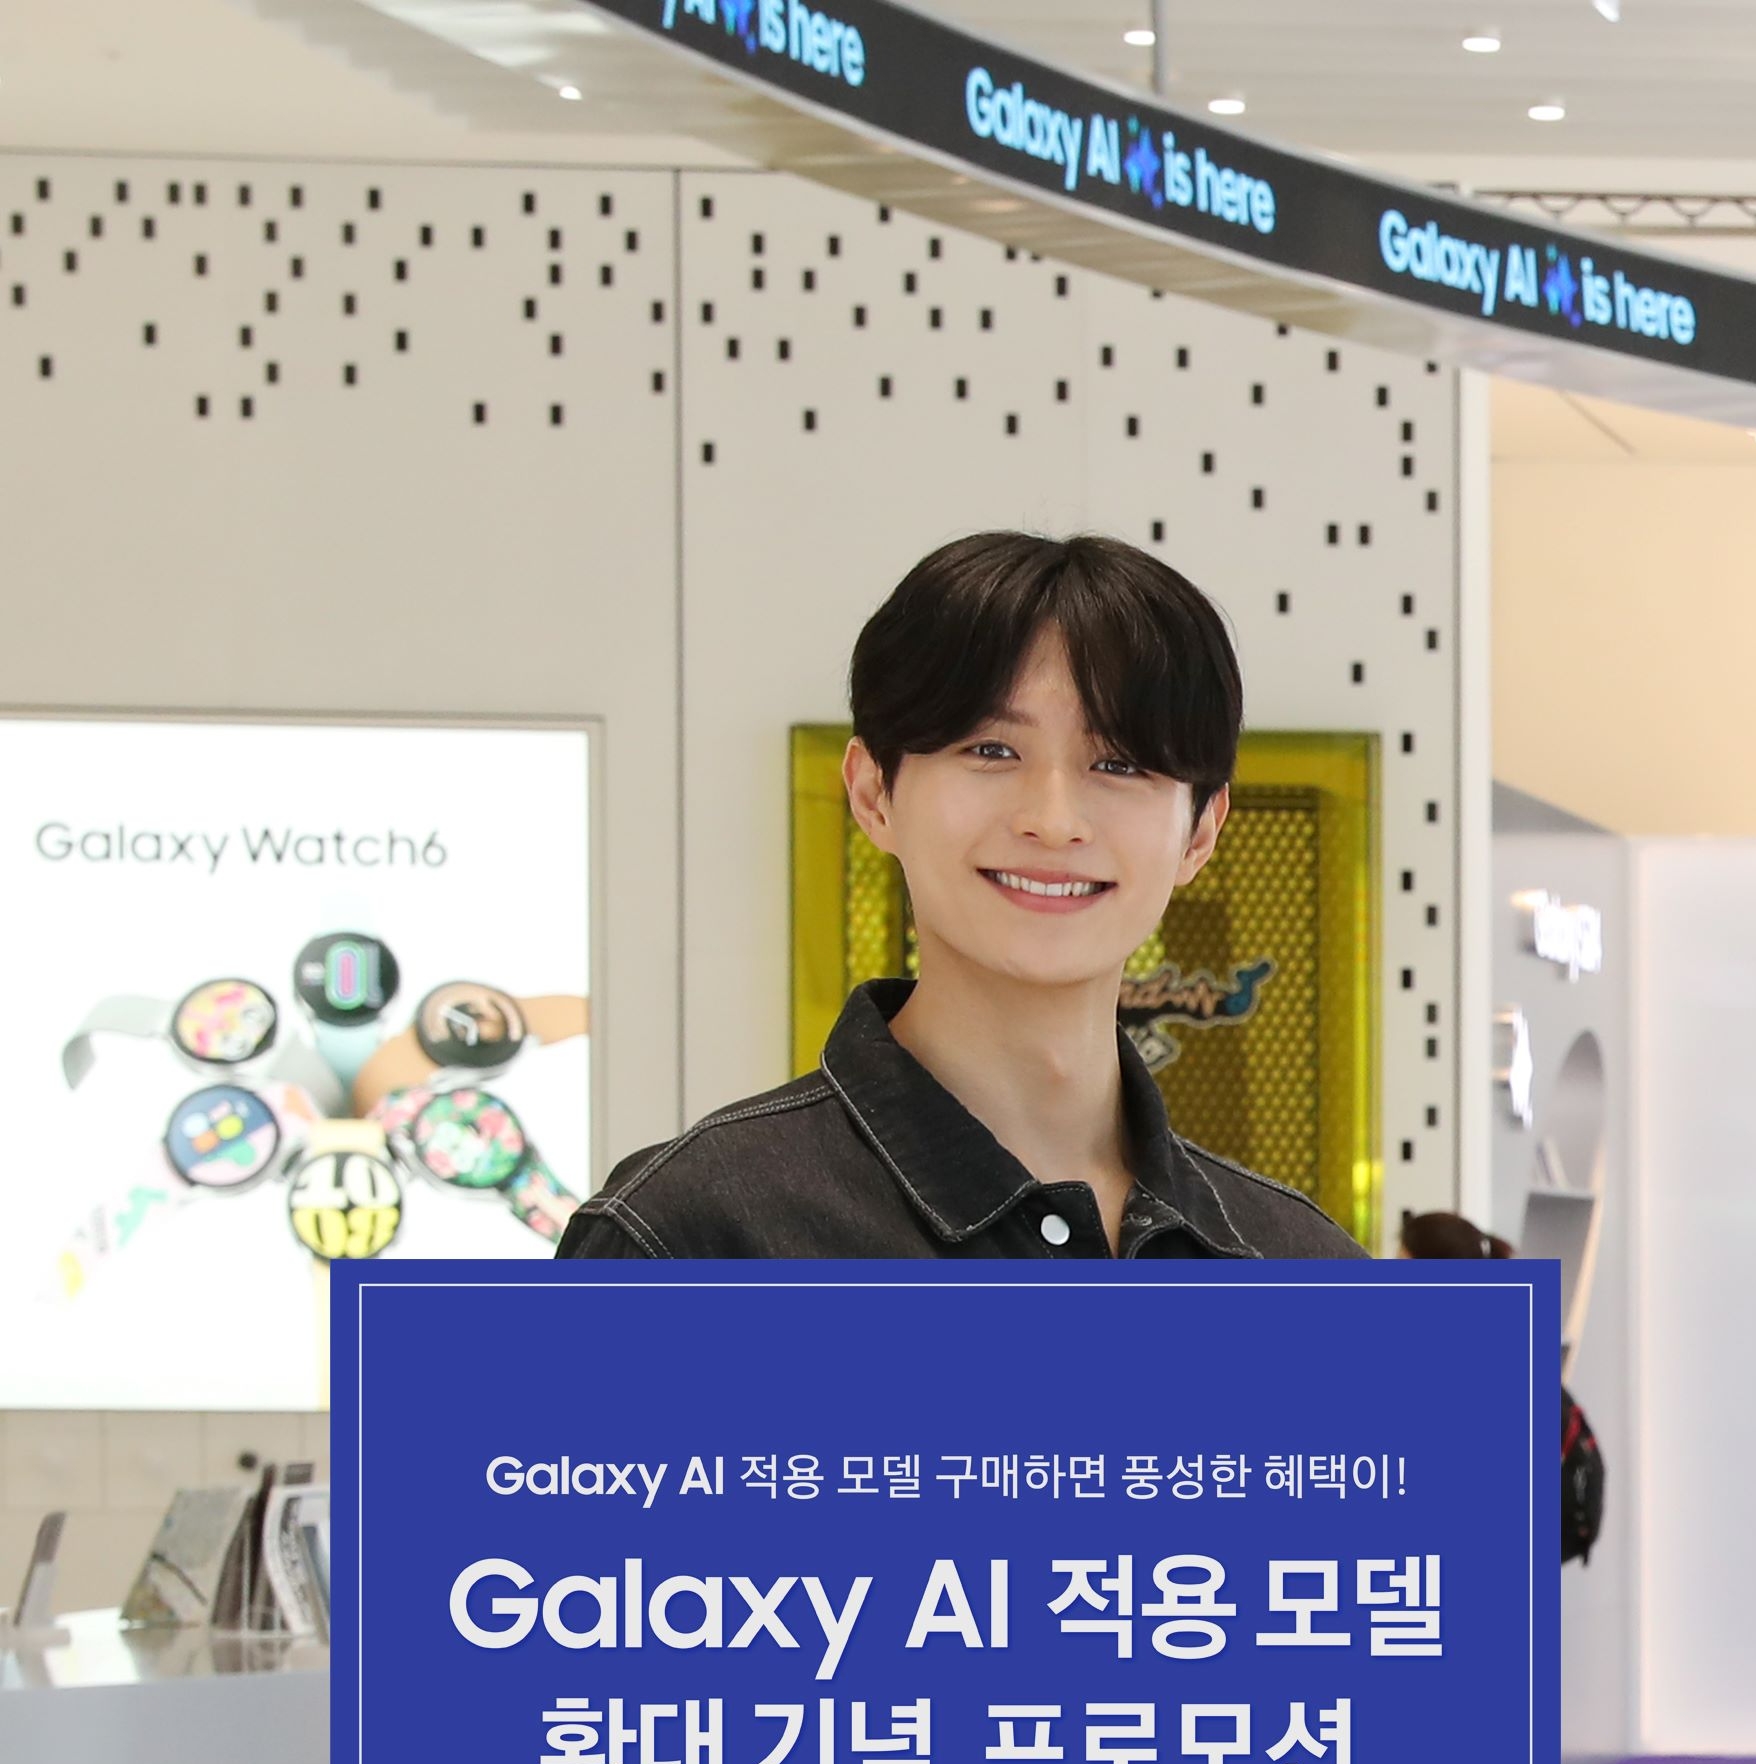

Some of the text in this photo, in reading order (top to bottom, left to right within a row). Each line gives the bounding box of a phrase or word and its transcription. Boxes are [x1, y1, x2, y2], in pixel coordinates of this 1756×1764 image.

[789, 0, 865, 86] here
[966, 66, 1276, 234] Galaxy AI is here
[1379, 208, 1696, 345] Galaxy AI is here
[35, 821, 448, 876] Galaxy Watch6
[486, 1455, 1405, 1508] Galaxy AI 적용 모델 구매하면 풍성한 혜택이!
[450, 1555, 1442, 1679] Galaxy AI 적용 모델
